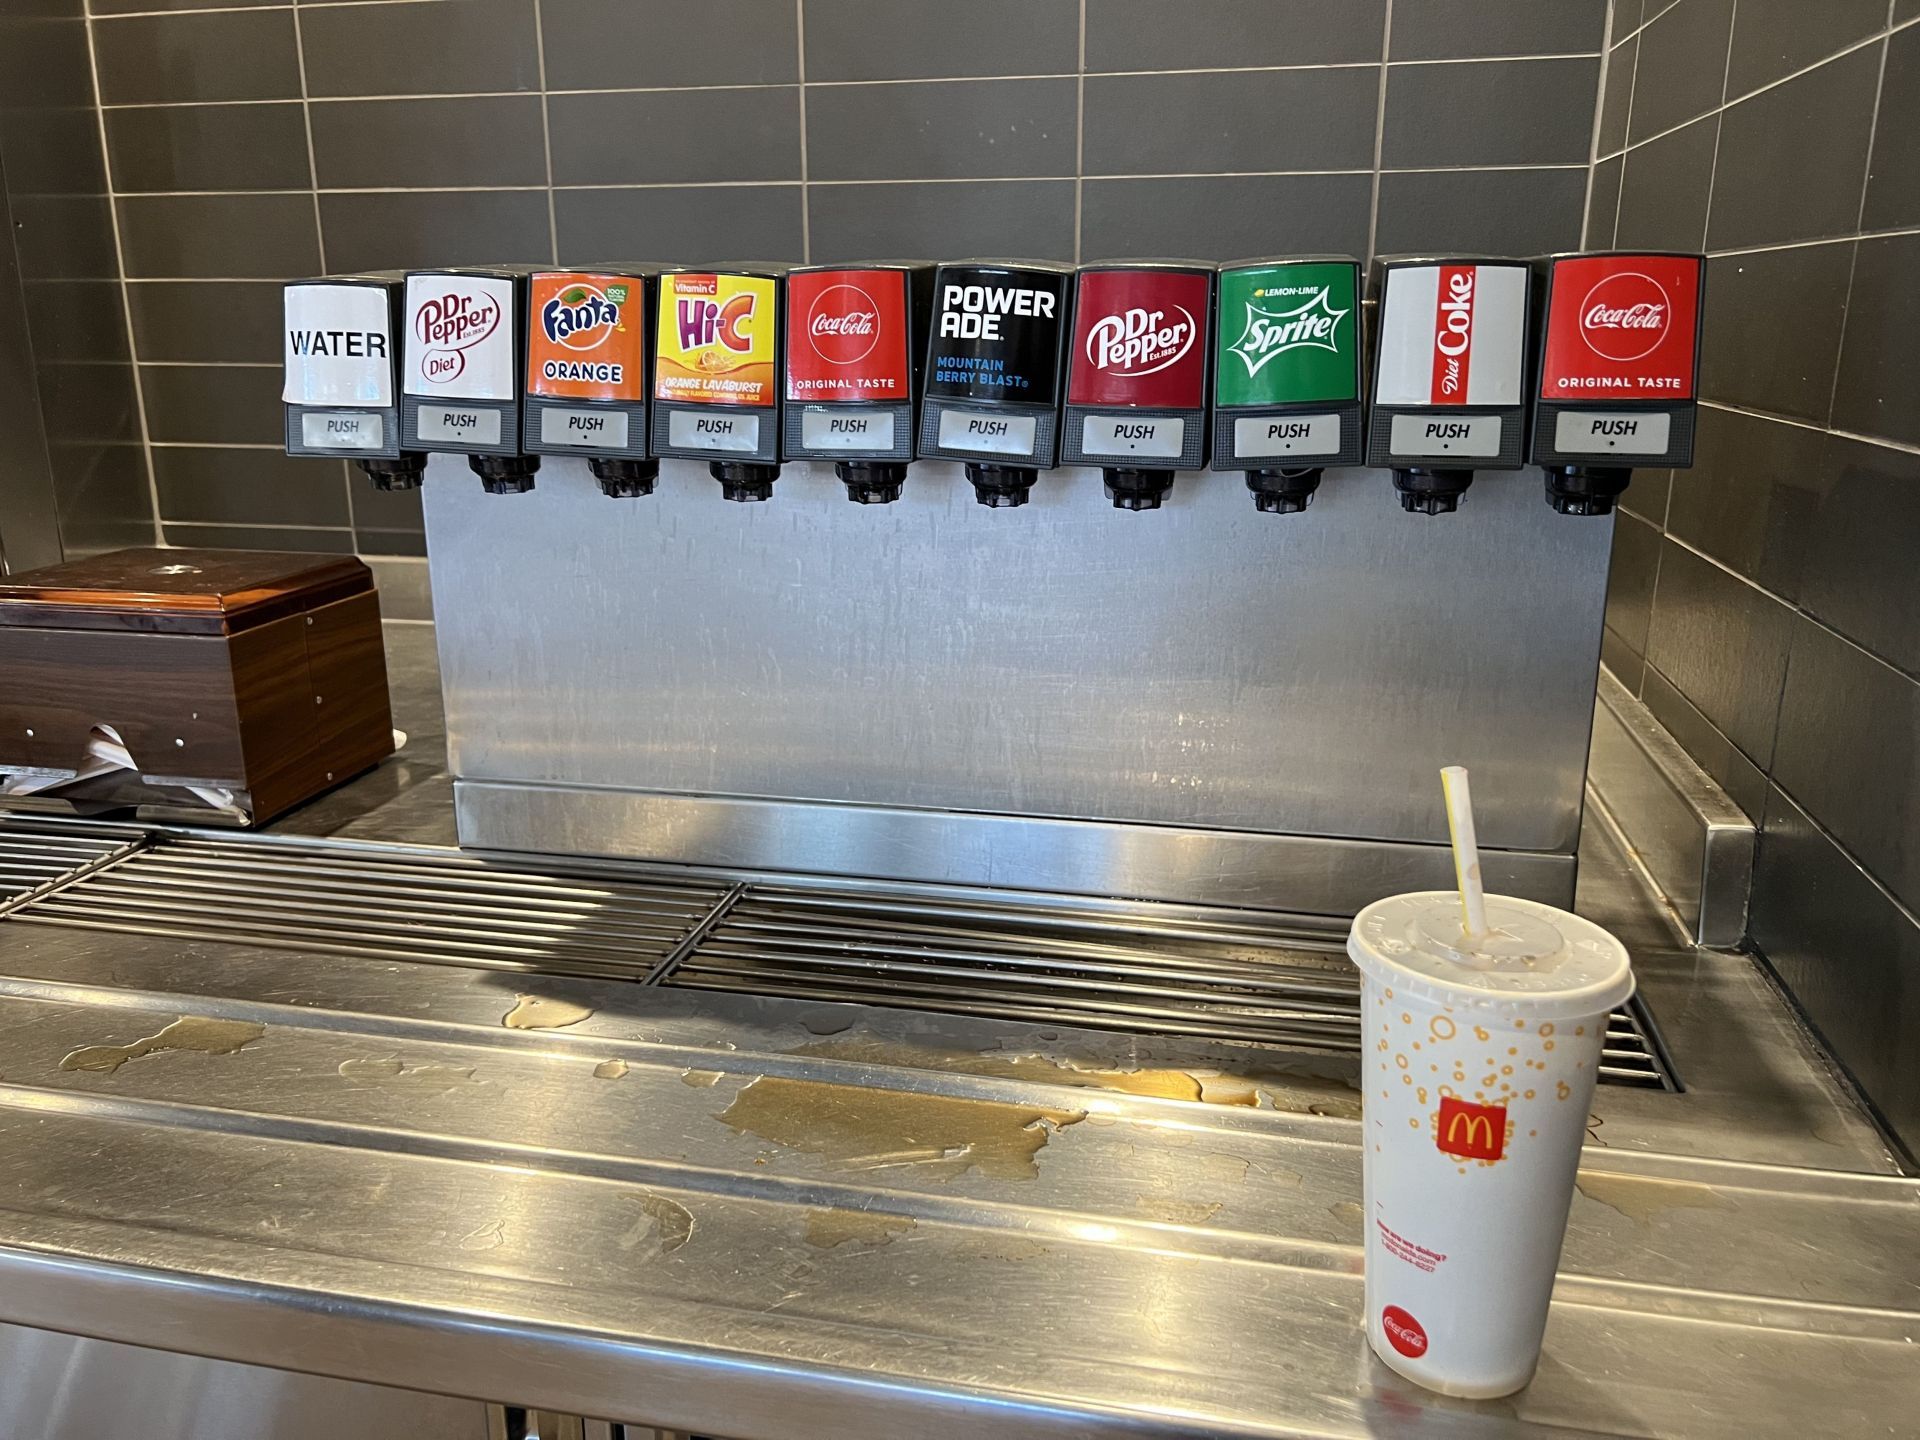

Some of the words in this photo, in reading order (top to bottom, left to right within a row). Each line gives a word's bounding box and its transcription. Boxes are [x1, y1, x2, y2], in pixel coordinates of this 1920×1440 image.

[675, 283, 708, 294] Vitamin
[708, 285, 715, 294] C
[1265, 287, 1318, 297] LEMON-LIME
[442, 293, 472, 315] Dr
[942, 285, 1055, 319] POWER
[422, 300, 493, 345] Pepper
[543, 296, 618, 342] Fanta
[678, 294, 756, 352] Hi-C
[1437, 273, 1473, 356] Coke
[1585, 303, 1665, 329] Coca-Cola
[812, 312, 875, 336] Coca-Cola
[1125, 308, 1164, 341] Dr
[1243, 312, 1331, 353] Sprite
[290, 331, 387, 358] WATER
[1094, 316, 1187, 370] Pepper
[430, 357, 455, 376] Diet
[937, 356, 1004, 371] MOUNTAIN
[544, 362, 622, 383] ORANGE
[936, 370, 976, 384] BERRY
[1441, 358, 1460, 395] Diet
[664, 376, 702, 389] ORANGE
[702, 379, 764, 394] LAVABURST
[797, 378, 852, 390] ORIGINAL
[857, 378, 895, 389] TASTE
[1558, 377, 1633, 389] ORIGINAL
[1638, 377, 1681, 389] TASTE
[326, 420, 360, 433] PUSH
[443, 413, 477, 428] PUSH
[568, 416, 604, 431] PUSH
[696, 419, 733, 434] PUSH
[830, 419, 868, 433] PUSH
[968, 420, 1008, 436] PUSH
[1591, 420, 1638, 436] PUSH
[1114, 424, 1155, 439] PUSH
[1267, 424, 1311, 439] PUSH
[1425, 424, 1471, 439] PUSH
